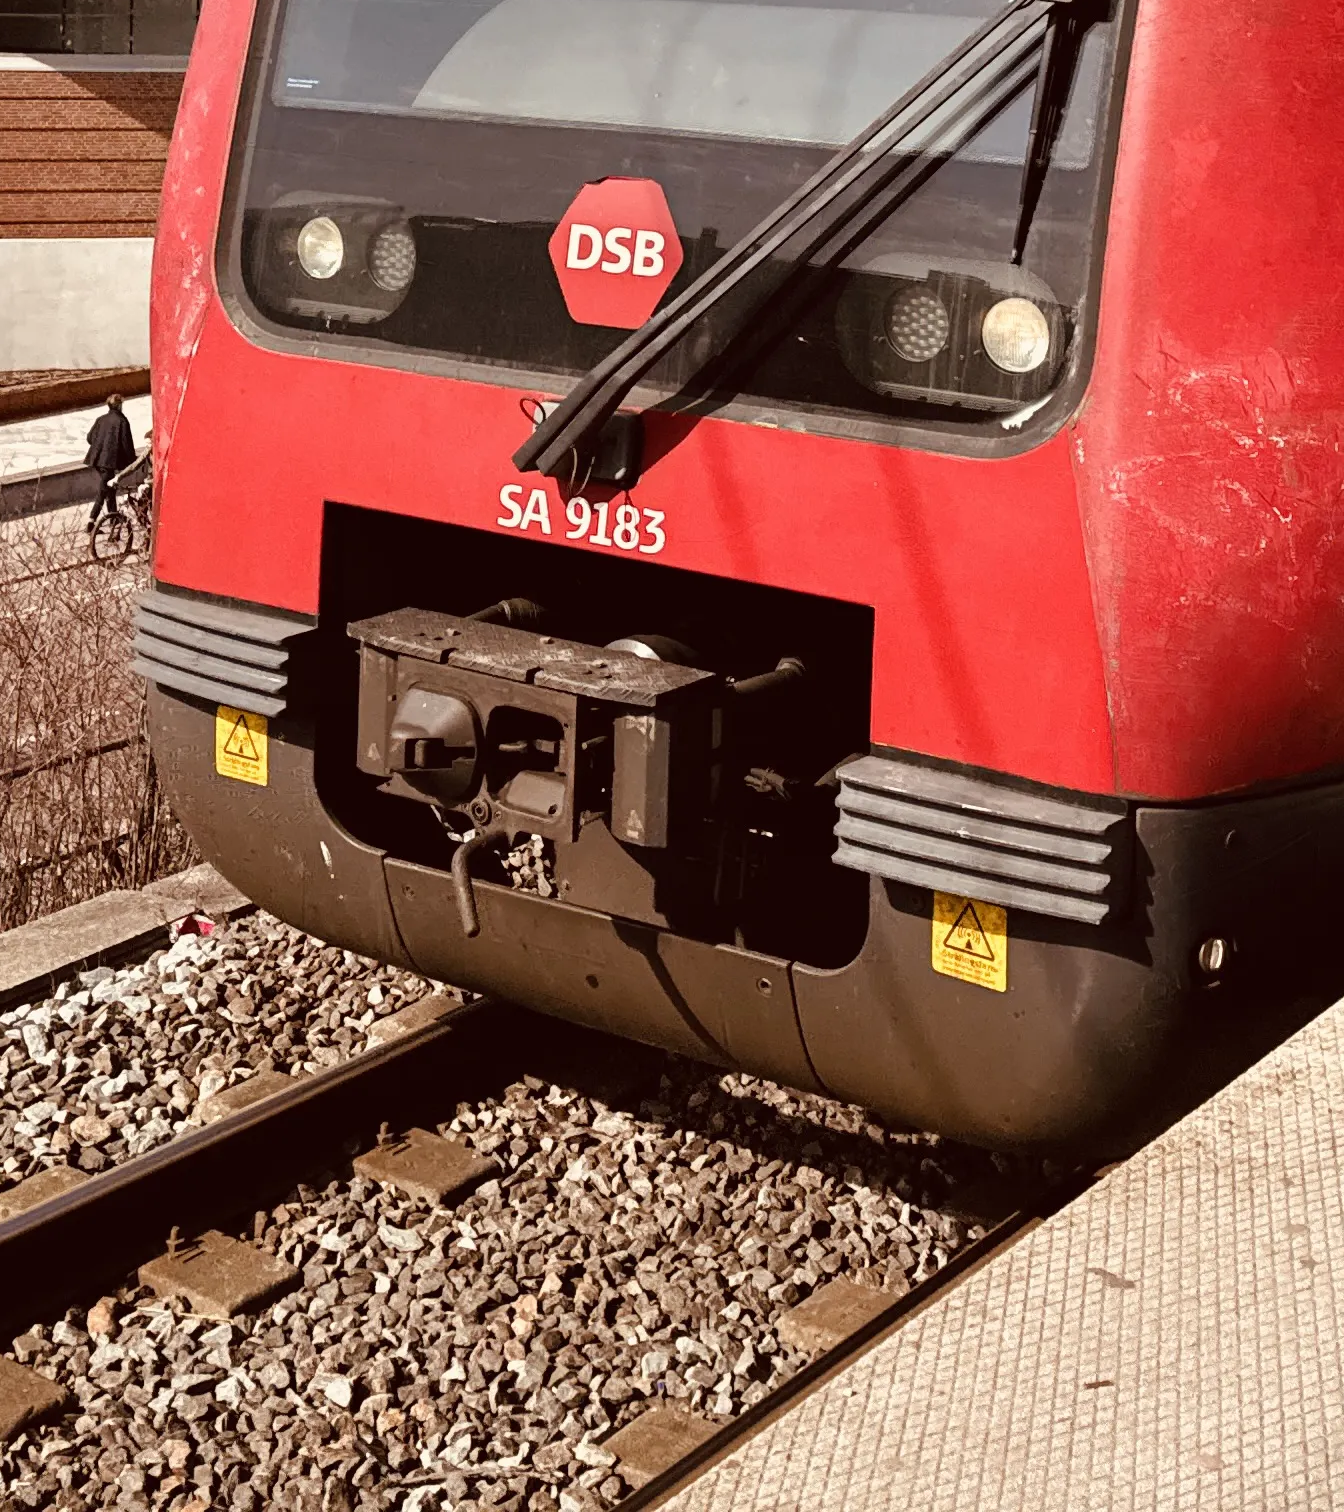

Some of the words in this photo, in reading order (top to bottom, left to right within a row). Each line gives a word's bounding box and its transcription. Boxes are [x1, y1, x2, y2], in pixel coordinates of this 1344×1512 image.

[566, 223, 665, 277] DSB
[496, 484, 552, 535] SA
[565, 496, 666, 554] 9183
